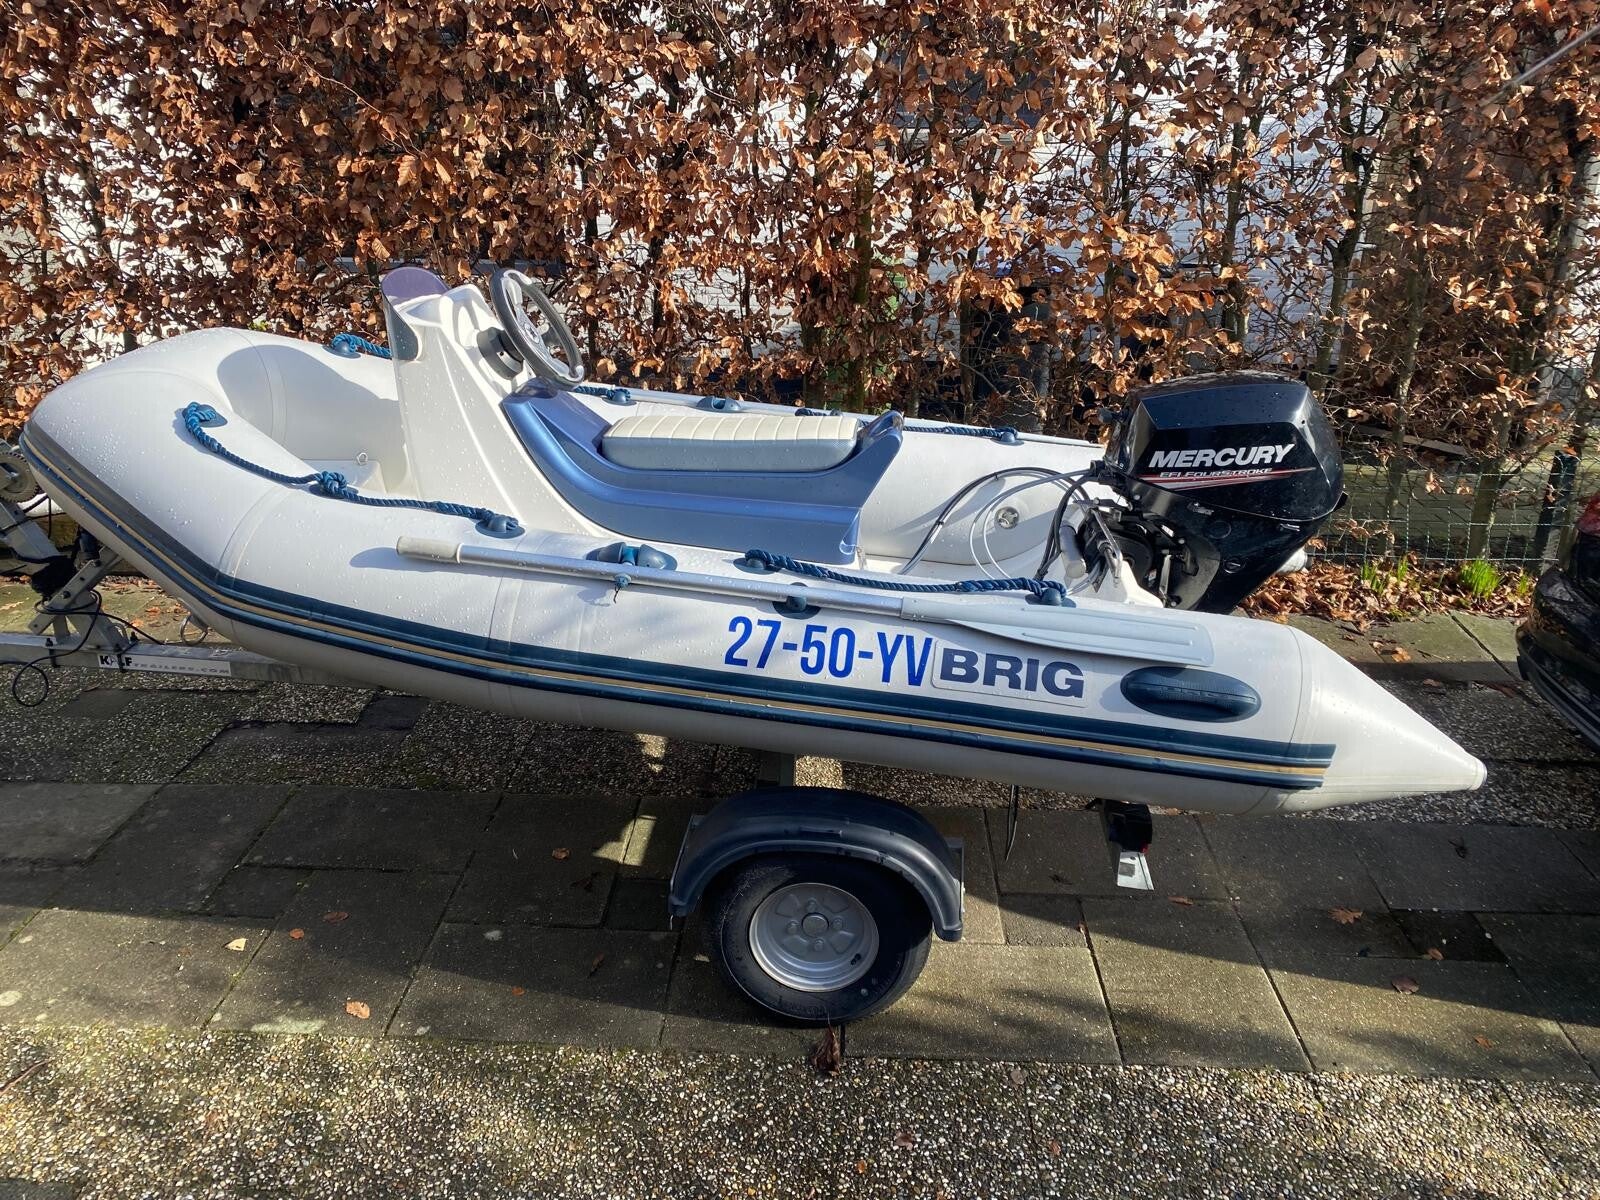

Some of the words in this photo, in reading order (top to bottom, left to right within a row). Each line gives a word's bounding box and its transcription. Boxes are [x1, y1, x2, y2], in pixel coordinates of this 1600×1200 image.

[1149, 443, 1295, 468] MERCURY
[1159, 471, 1182, 479] EFI
[725, 615, 933, 687] 27-50-YV
[940, 648, 1084, 698] BRIG
